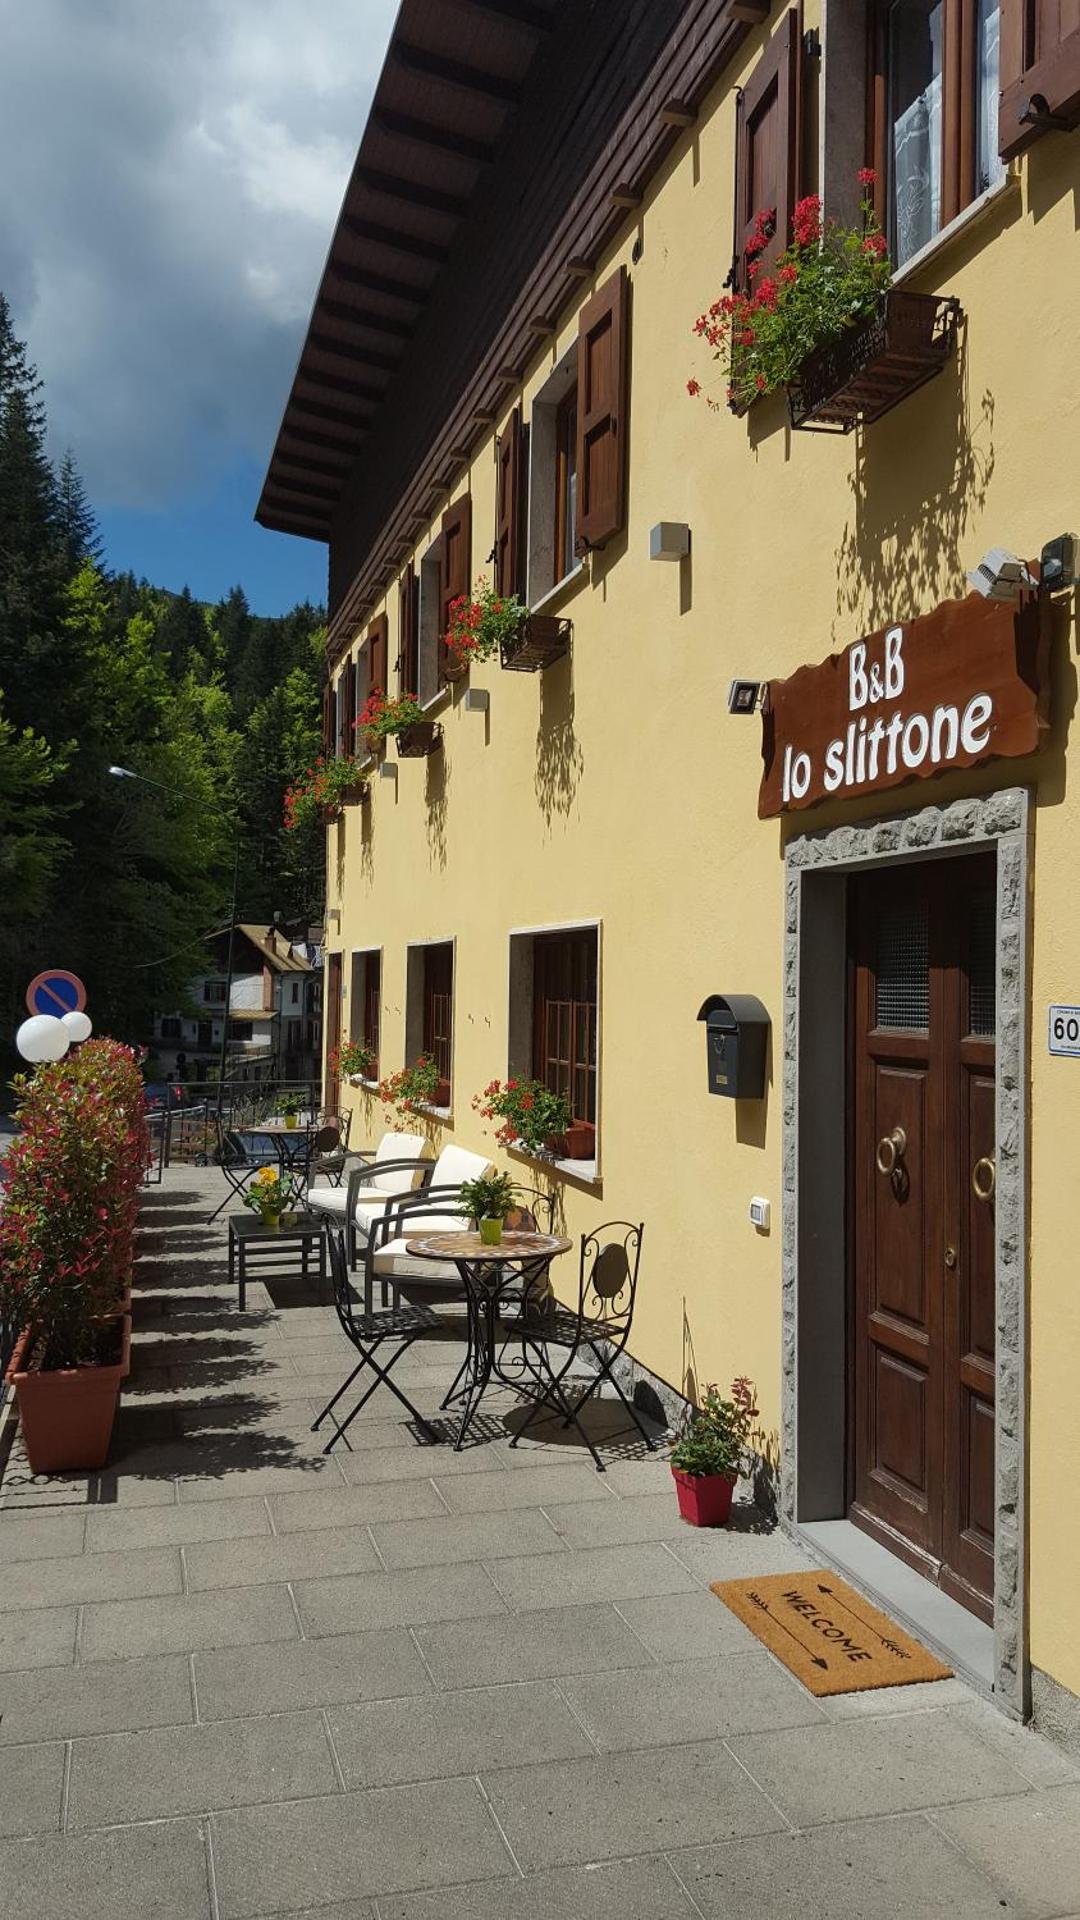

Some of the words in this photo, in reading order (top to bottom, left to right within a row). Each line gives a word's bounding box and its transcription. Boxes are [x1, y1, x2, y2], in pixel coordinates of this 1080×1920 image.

[849, 626, 905, 711] B&B
[782, 744, 811, 802] lo
[823, 692, 993, 792] slittone
[1054, 1017, 1079, 1041] 60
[780, 1590, 873, 1662] WELCOME
